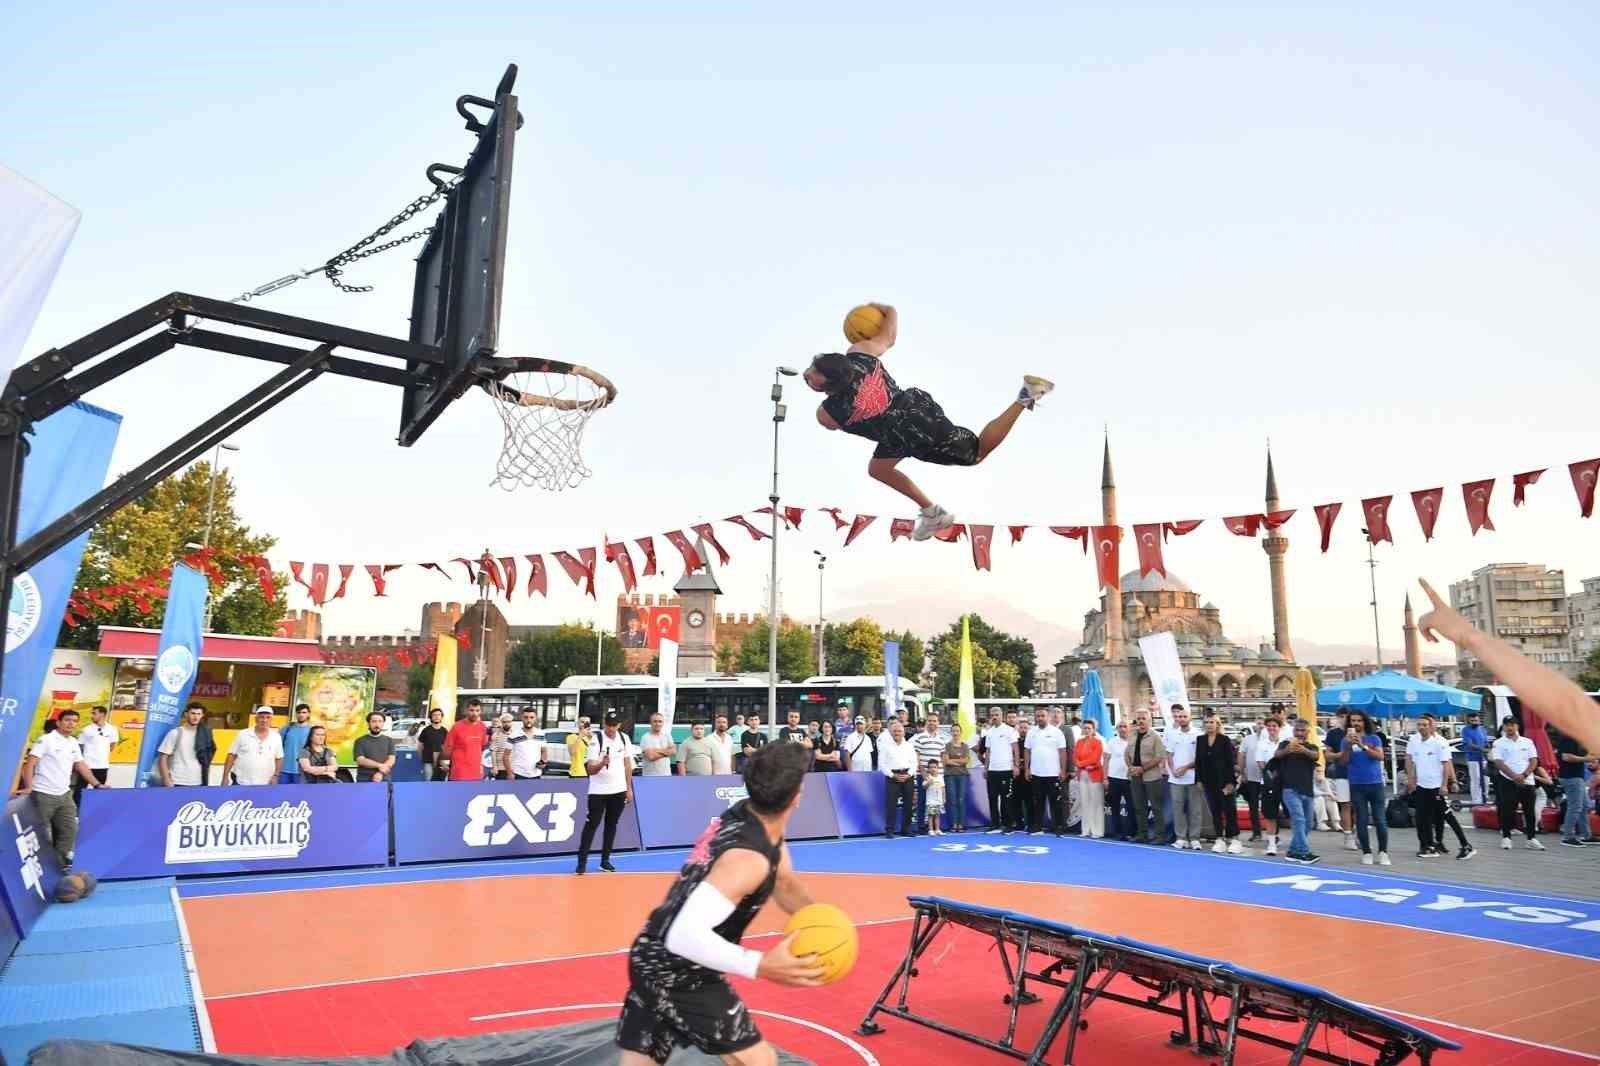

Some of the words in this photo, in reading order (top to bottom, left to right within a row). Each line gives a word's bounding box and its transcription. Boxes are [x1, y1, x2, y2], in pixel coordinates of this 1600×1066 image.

[178, 802, 213, 825] Dr.
[216, 800, 307, 822] Memduh
[178, 821, 308, 848] BÜYÜKKILIÇ
